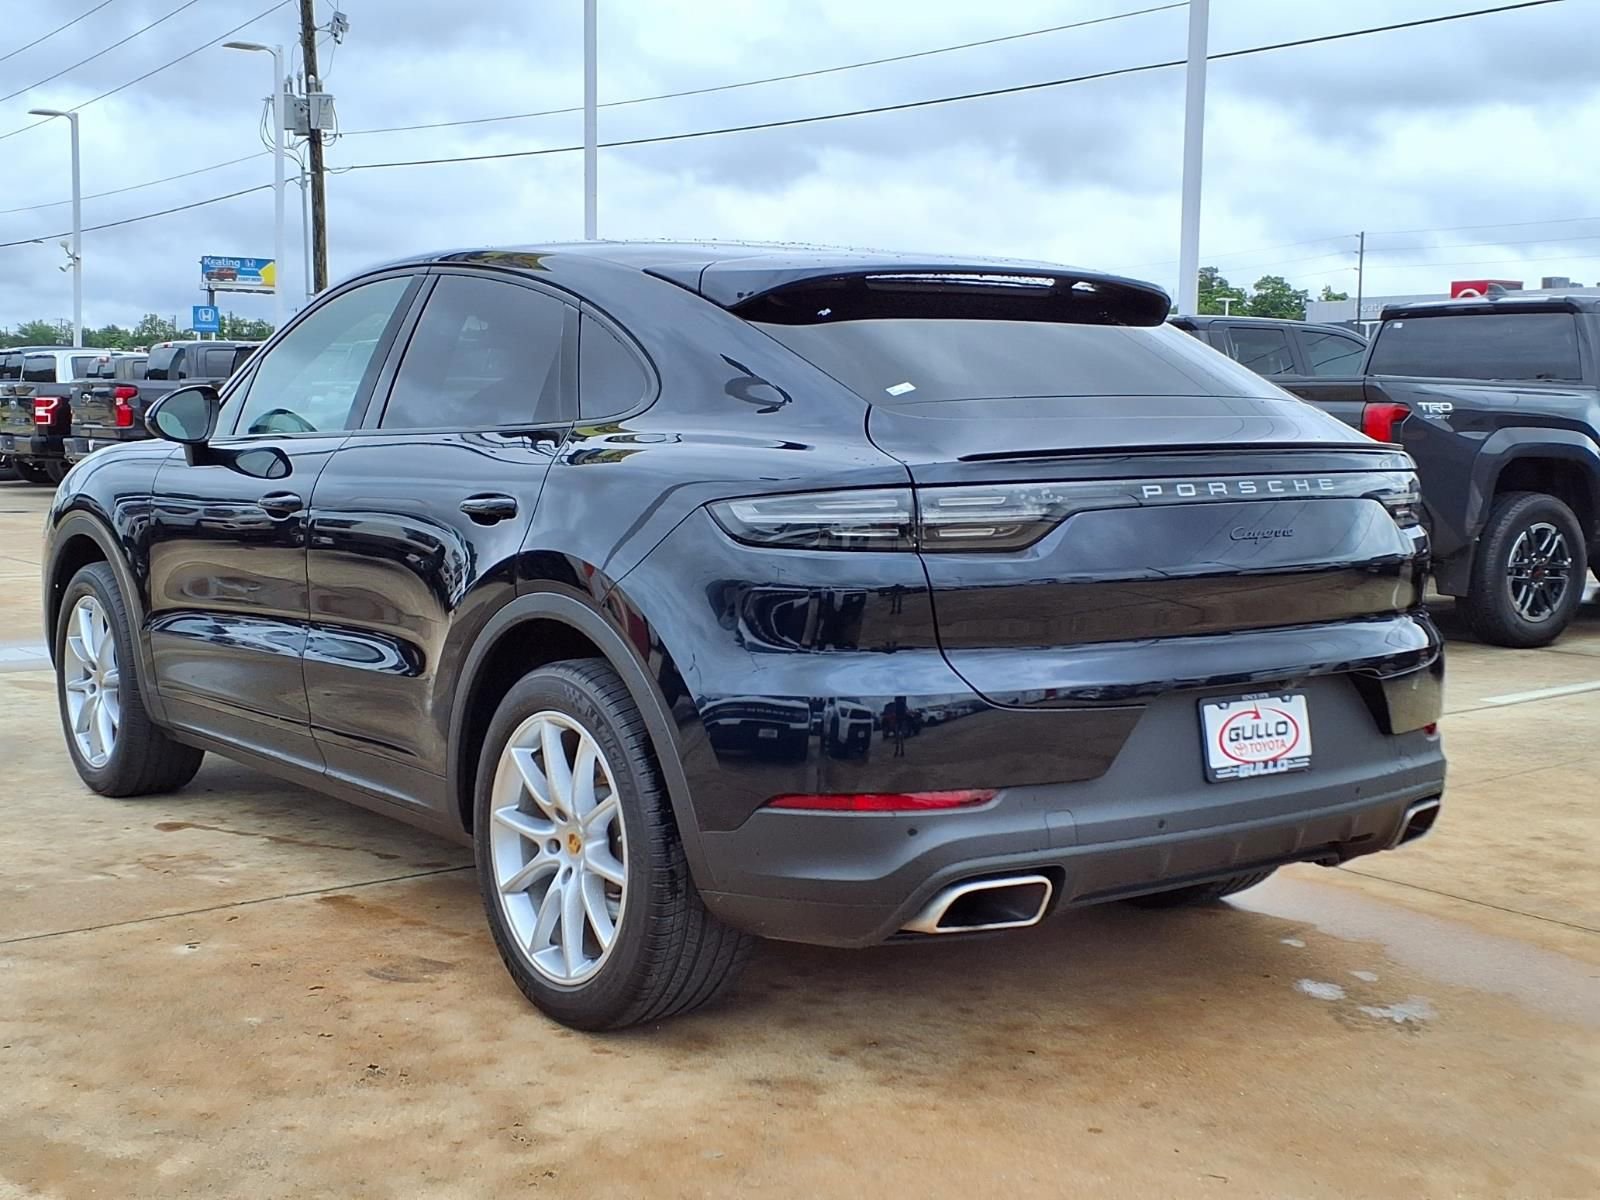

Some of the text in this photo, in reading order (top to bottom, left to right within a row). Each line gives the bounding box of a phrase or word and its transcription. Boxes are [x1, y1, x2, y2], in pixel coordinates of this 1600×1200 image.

[204, 257, 241, 269] Keating
[1416, 401, 1453, 414] TRD
[1141, 477, 1336, 499] PORSCHE
[1229, 526, 1296, 544] Cayenne
[1228, 720, 1289, 743] GULLO
[1249, 739, 1288, 753] TOYOTA
[1238, 759, 1289, 778] GULLO
